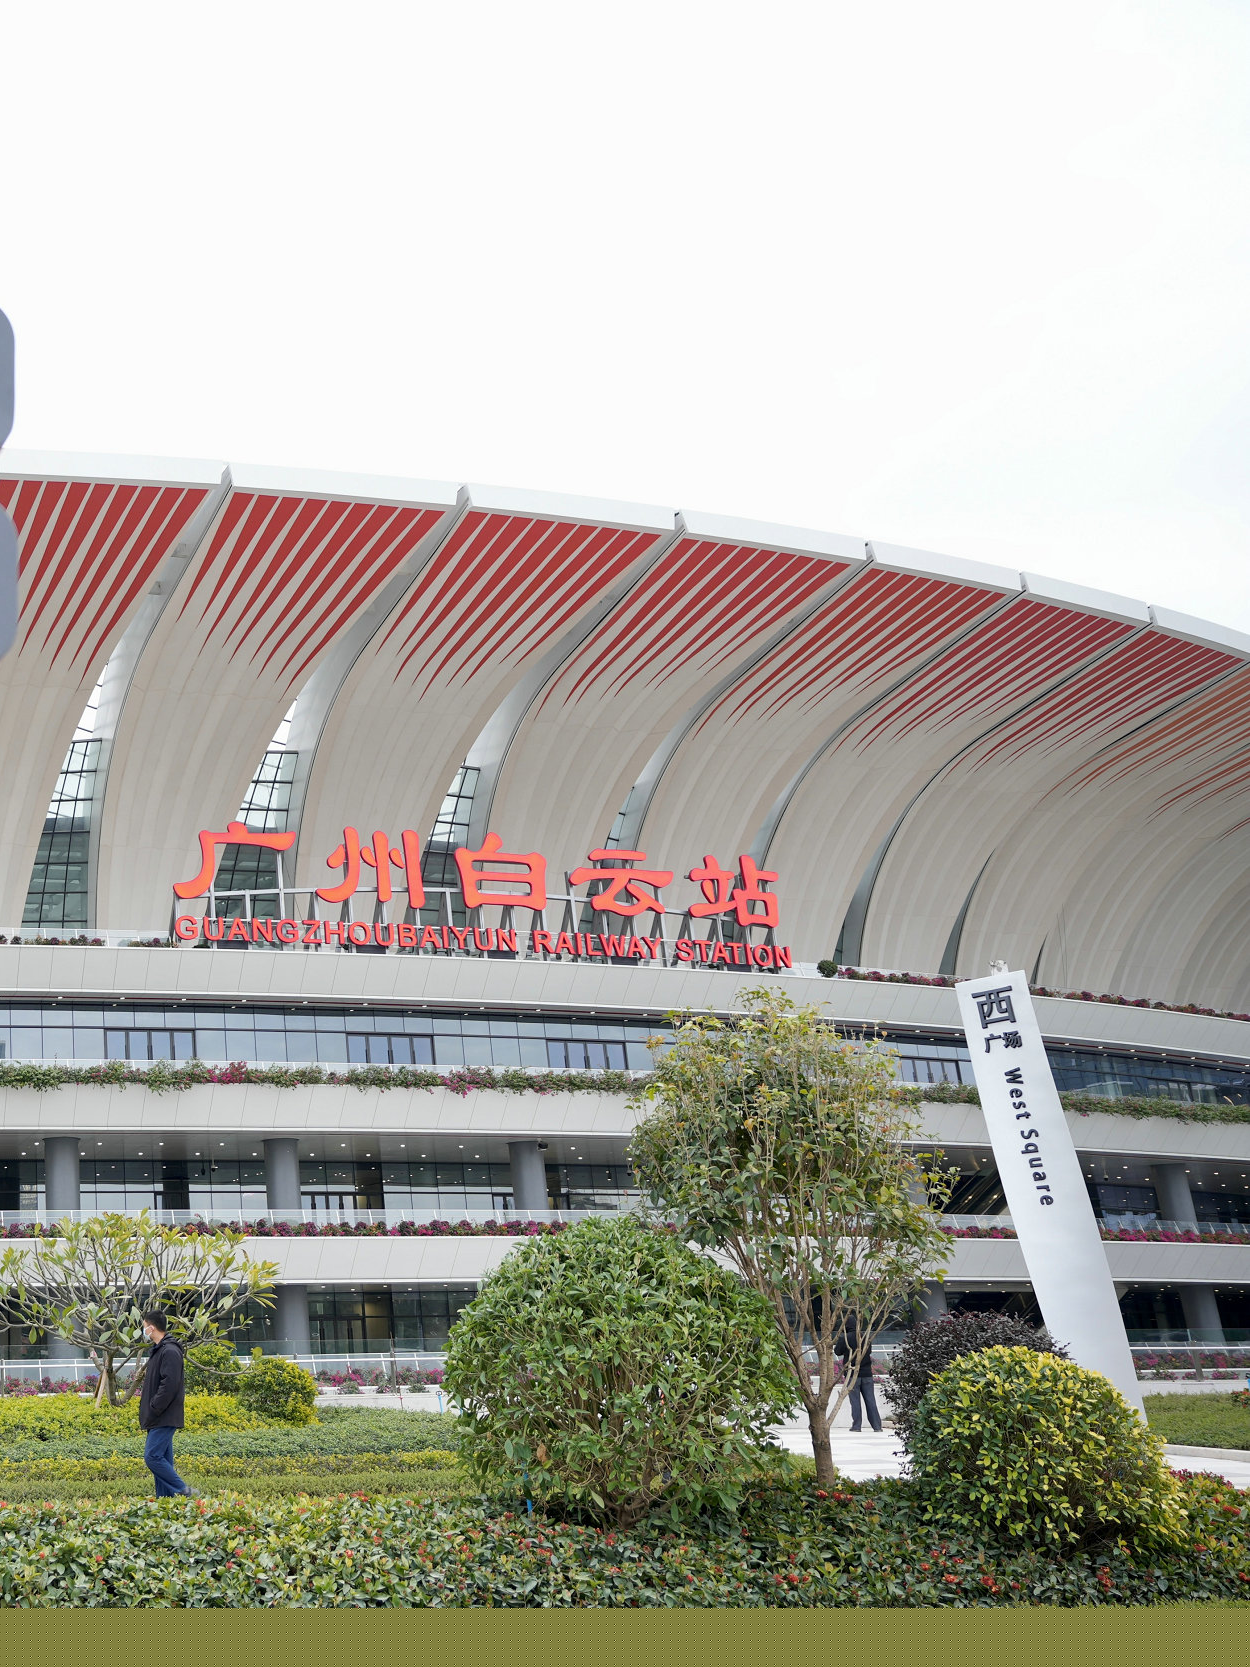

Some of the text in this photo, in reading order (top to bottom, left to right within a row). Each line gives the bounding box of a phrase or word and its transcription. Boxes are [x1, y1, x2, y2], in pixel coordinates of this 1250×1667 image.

[172, 821, 780, 928] 广州白云站
[174, 915, 793, 969] GUANGZHOUBAIYUN RAILWAY STATION
[1004, 1066, 1054, 1207] West Square
